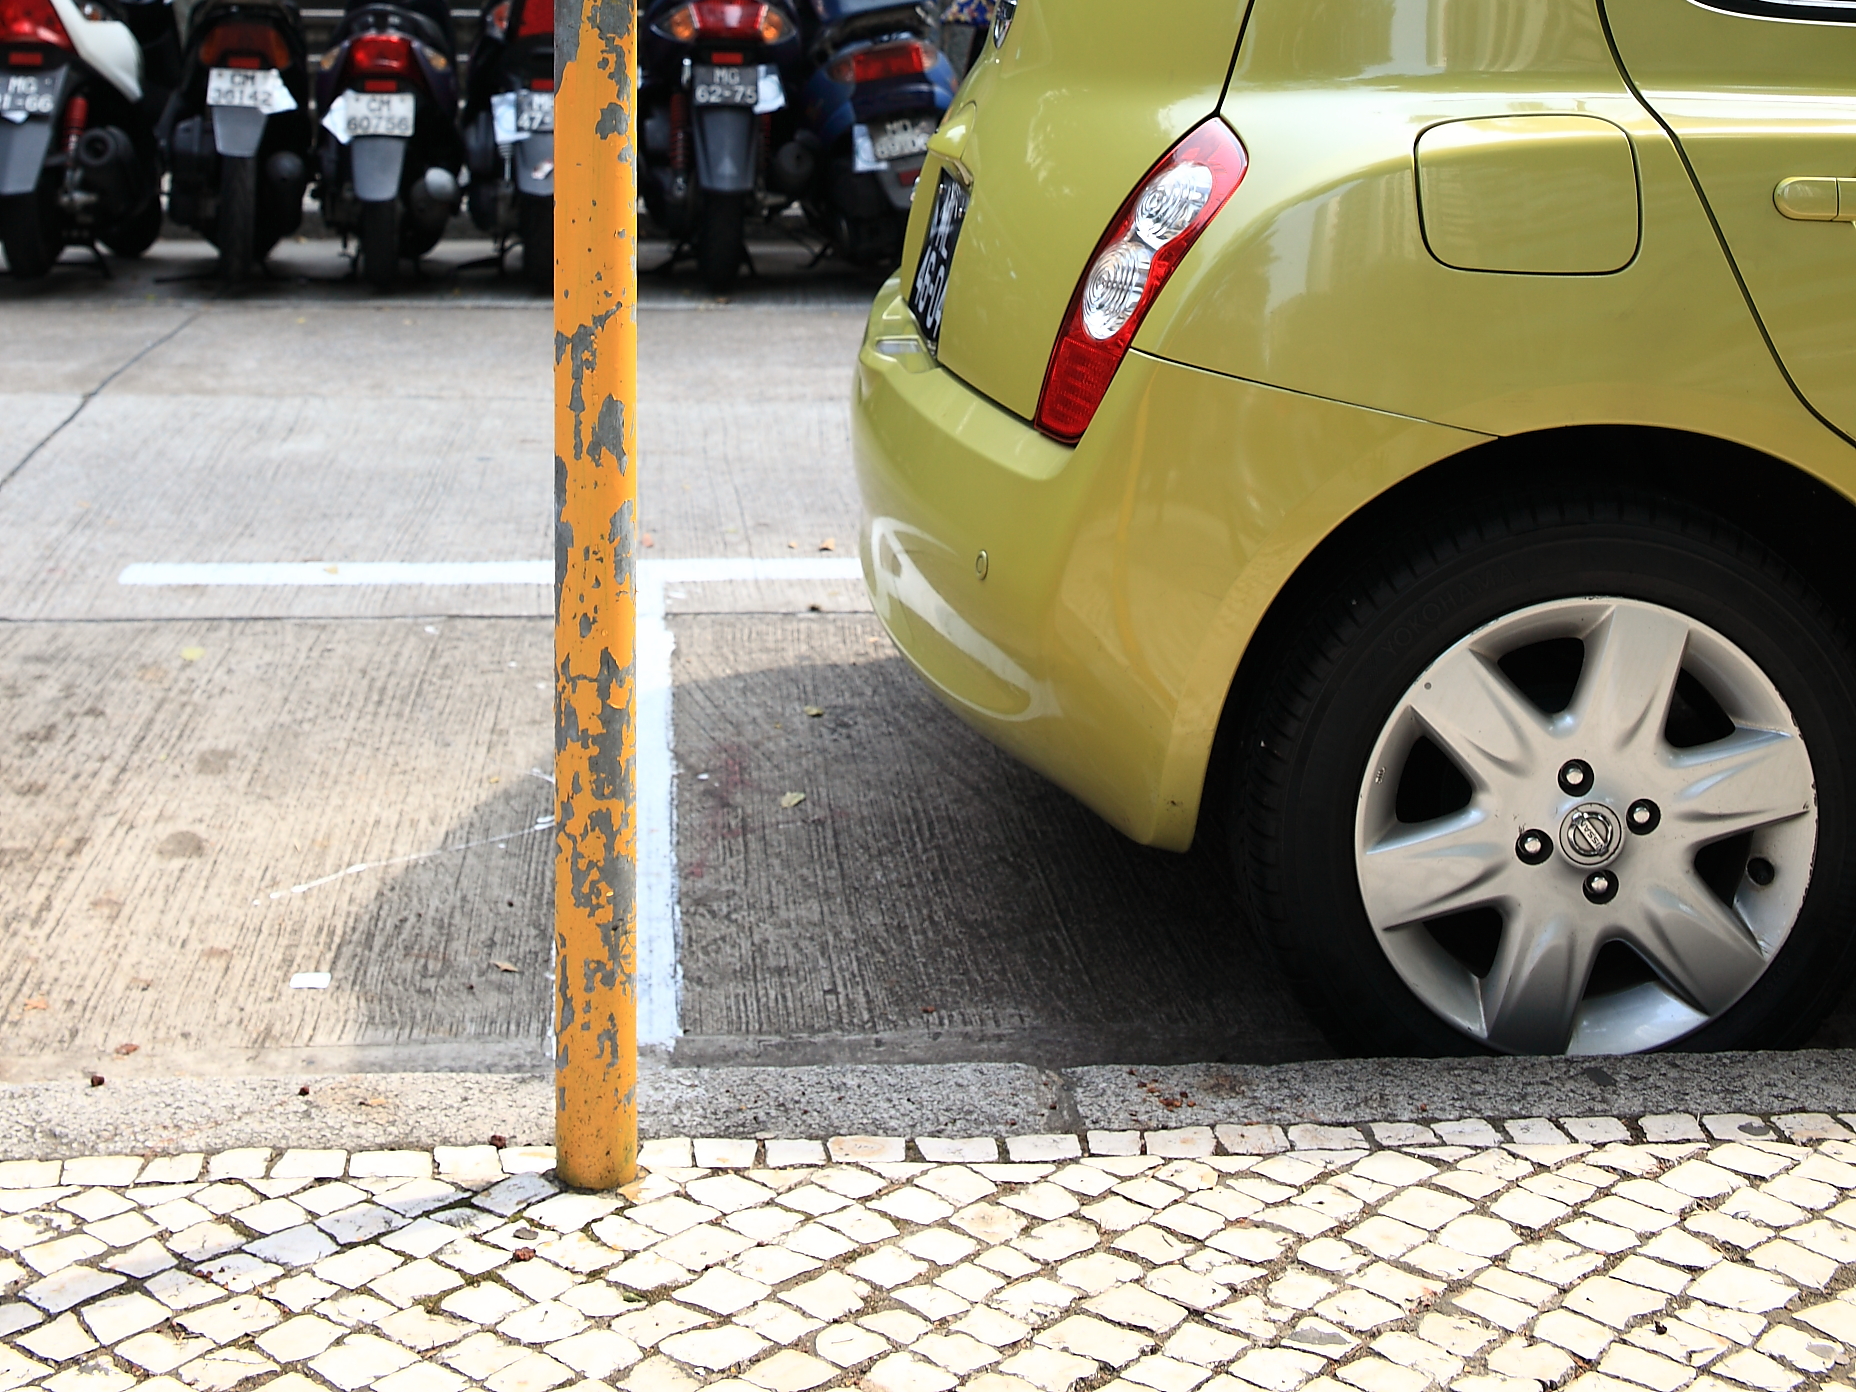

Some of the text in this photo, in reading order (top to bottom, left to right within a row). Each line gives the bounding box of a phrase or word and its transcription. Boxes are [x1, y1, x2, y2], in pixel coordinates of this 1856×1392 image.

[8, 75, 38, 94] MG
[713, 67, 741, 84] MG
[0, 93, 54, 113] 1-66
[695, 84, 757, 104] 62-75
[366, 97, 391, 112] CM
[1578, 818, 1606, 852] NISSAN
